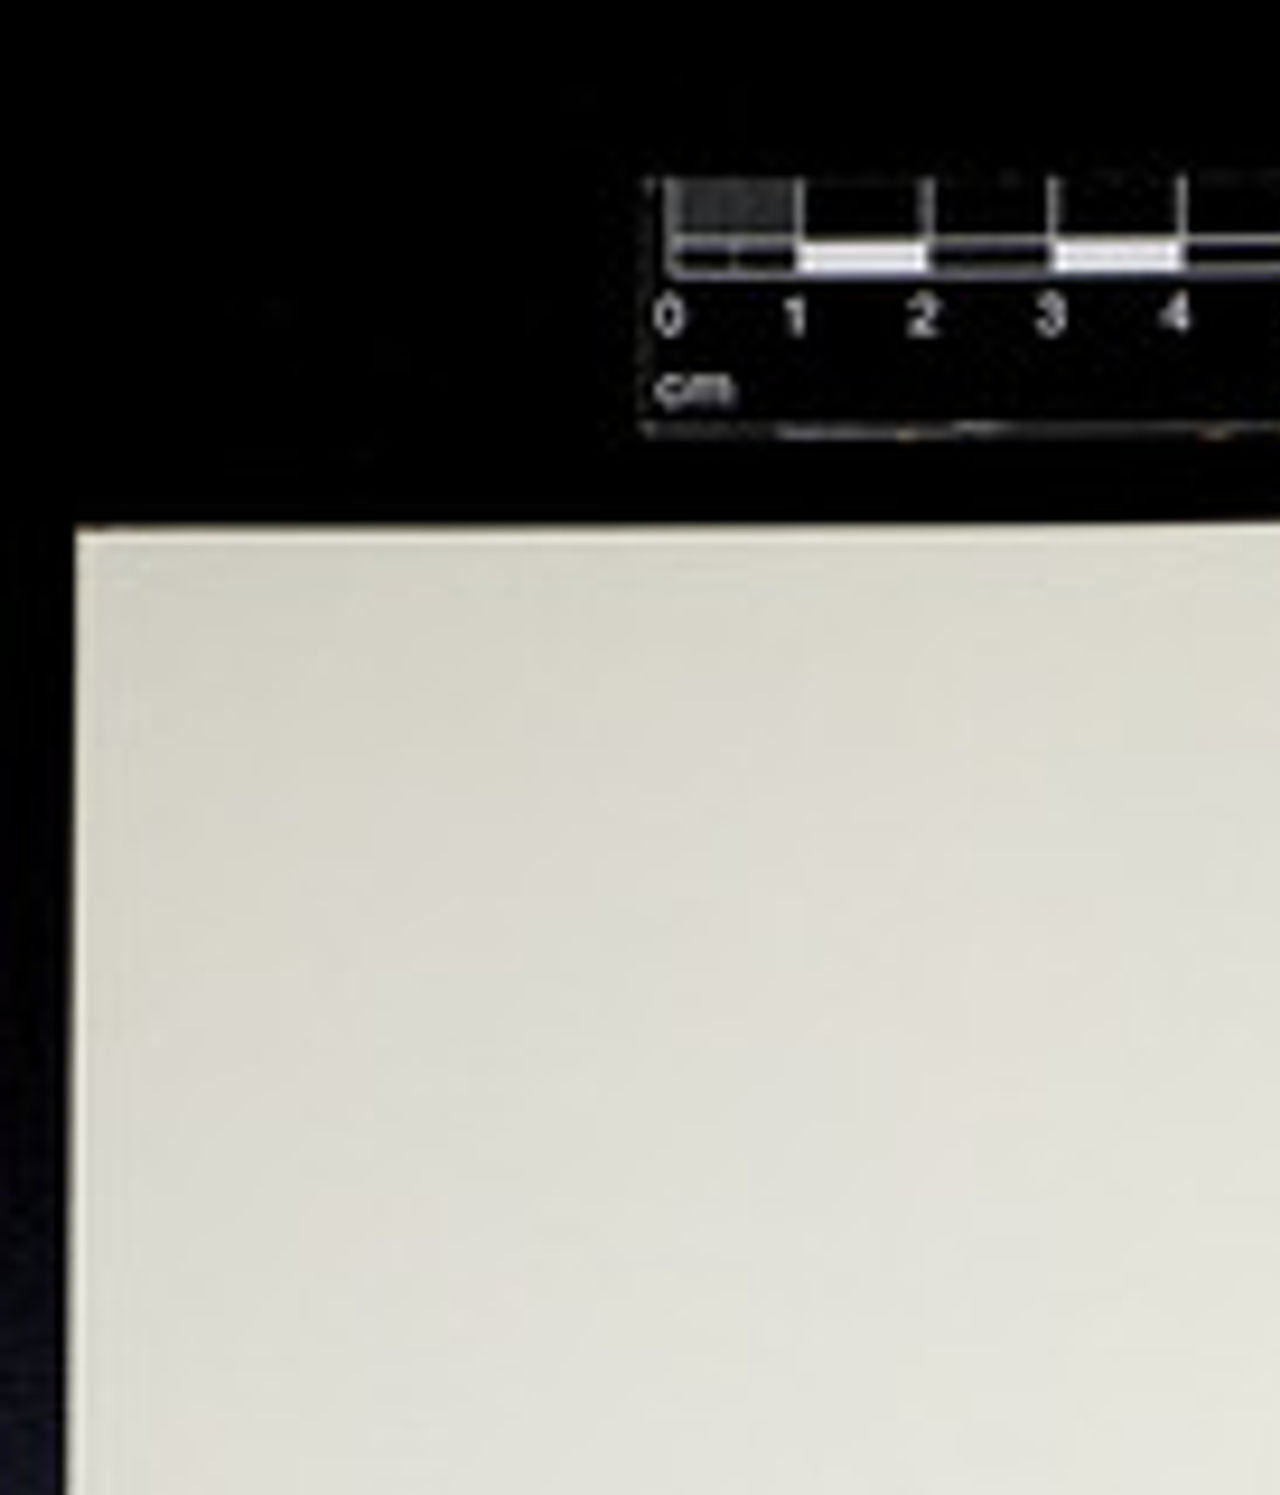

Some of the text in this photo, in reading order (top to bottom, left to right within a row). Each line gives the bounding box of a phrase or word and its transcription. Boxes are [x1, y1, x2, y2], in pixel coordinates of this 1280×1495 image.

[652, 289, 687, 339] 0
[783, 295, 807, 337] 1
[906, 290, 942, 339] 2
[1034, 288, 1068, 339] 3
[1160, 290, 1191, 332] 4
[652, 372, 737, 411] cm
